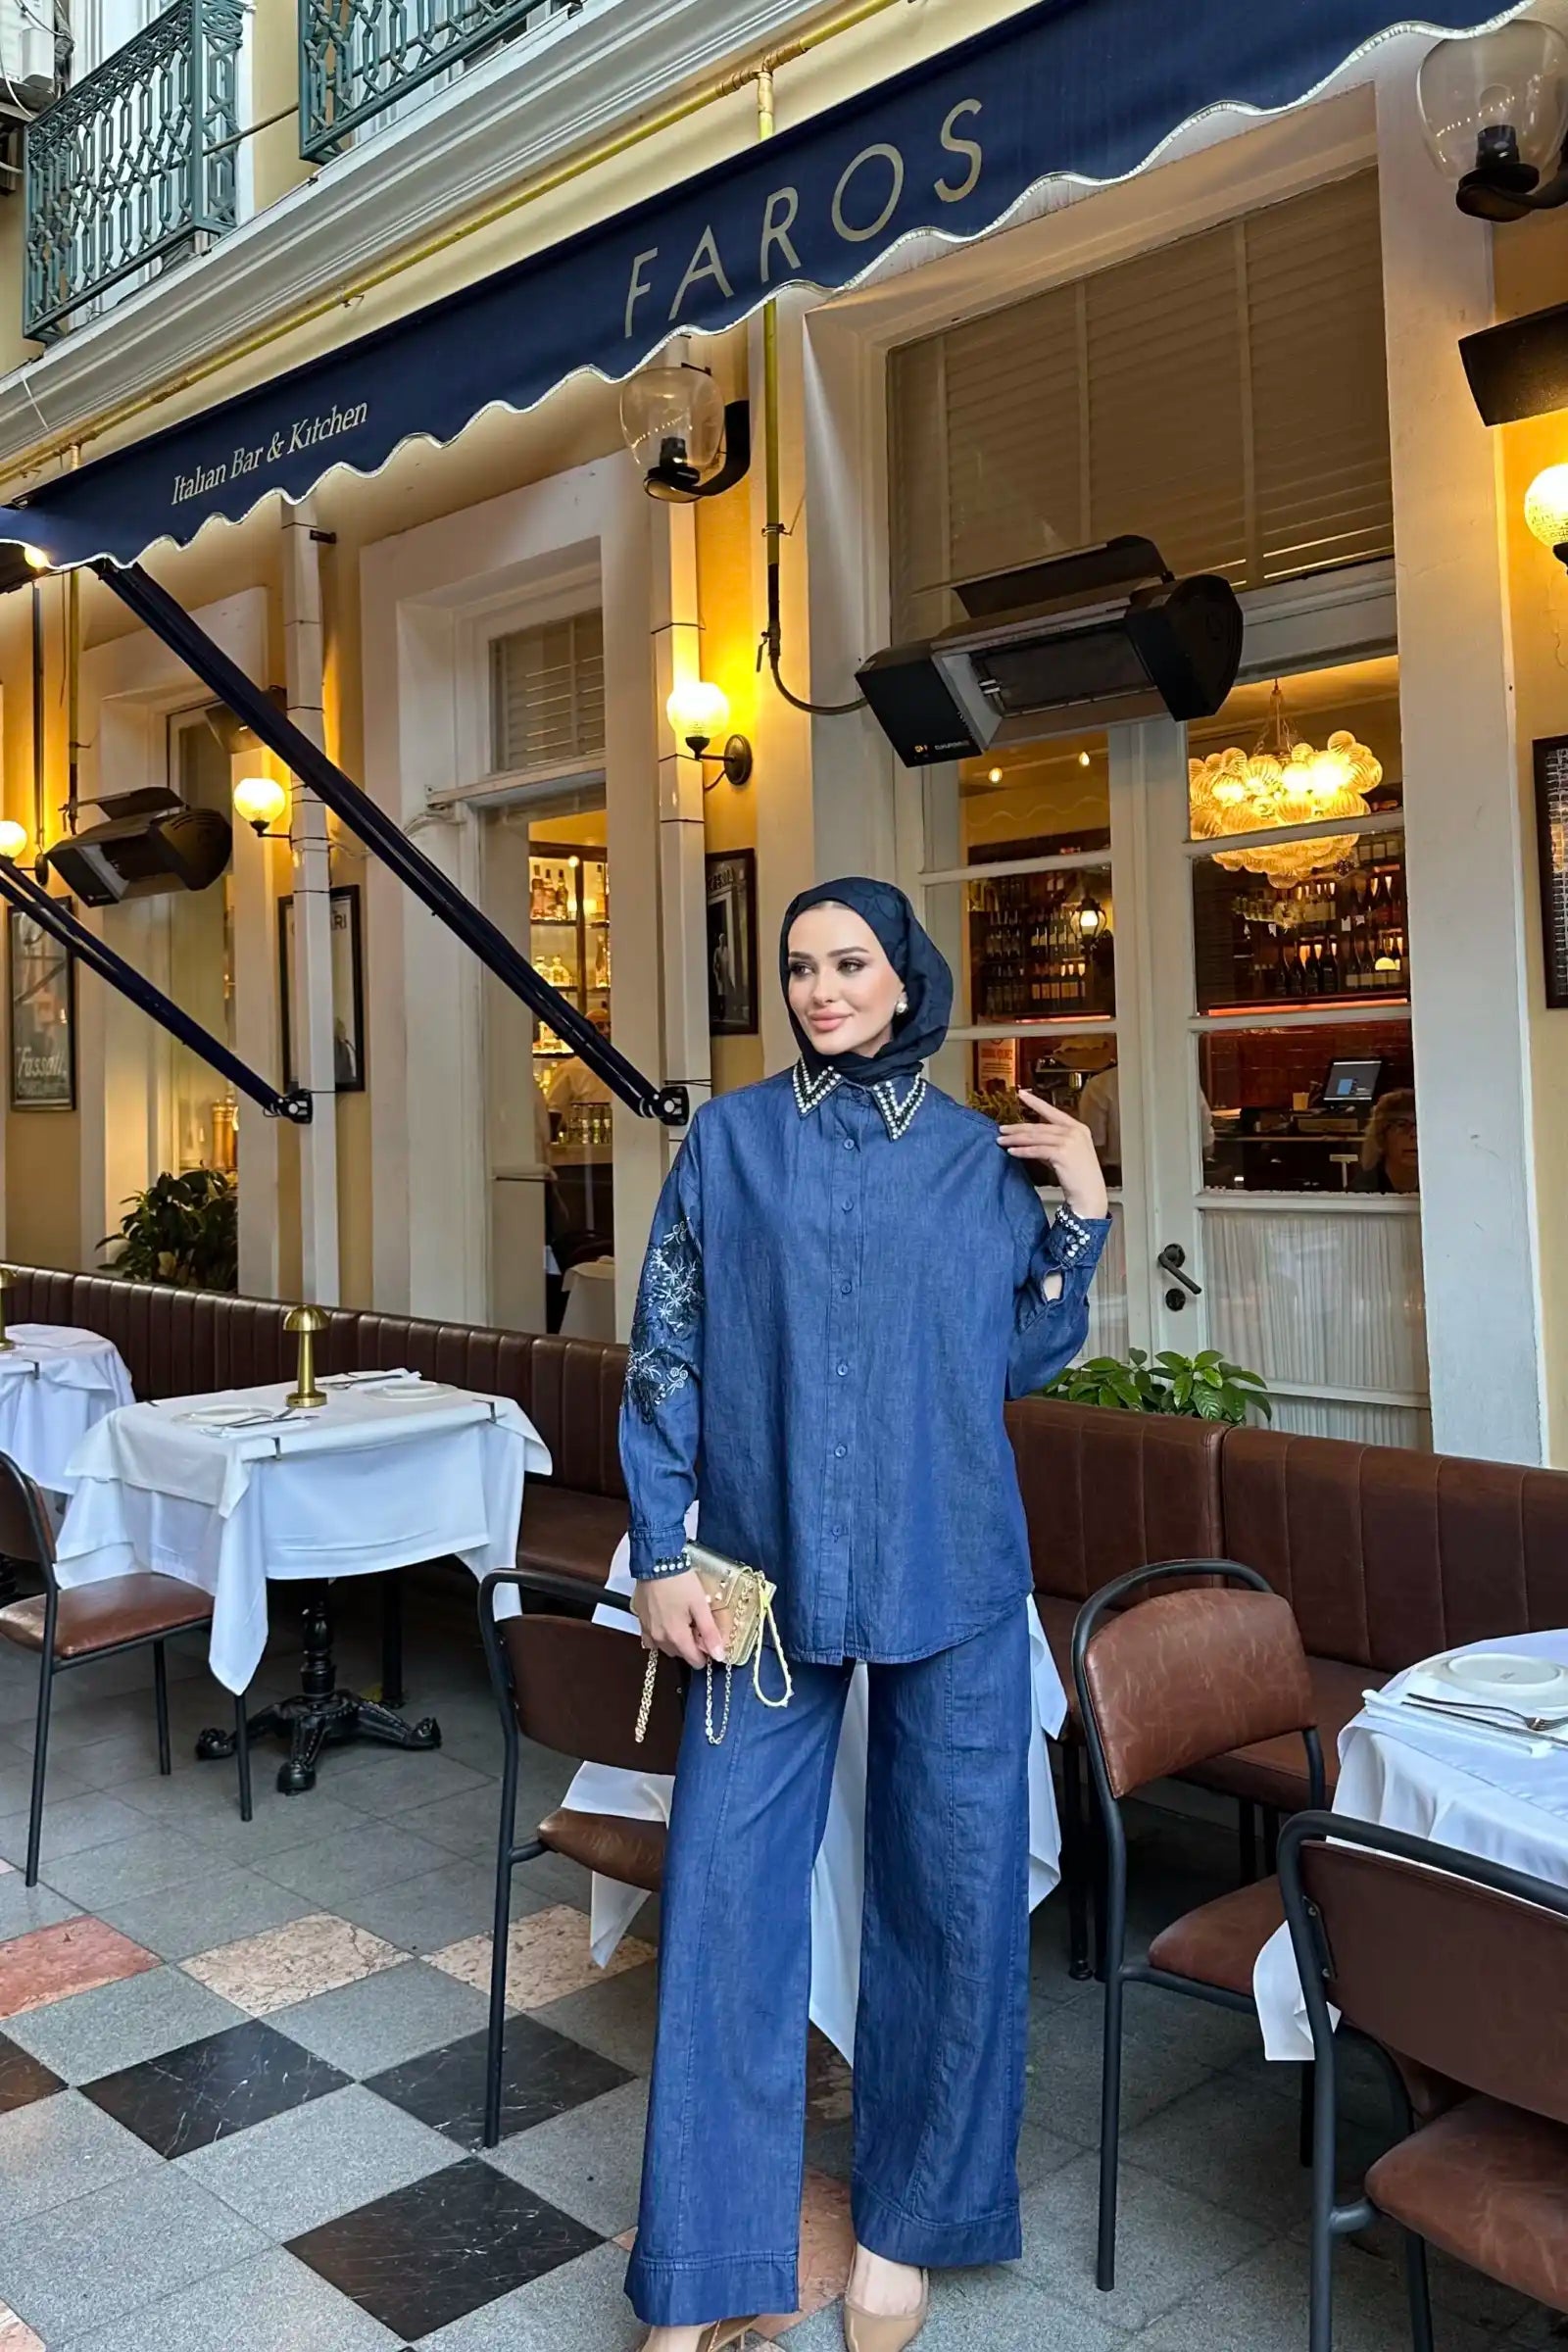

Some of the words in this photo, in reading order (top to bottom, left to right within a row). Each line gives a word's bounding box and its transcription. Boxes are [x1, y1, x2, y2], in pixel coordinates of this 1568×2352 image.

[624, 98, 982, 338] FAROS
[171, 463, 226, 506] Italian
[230, 447, 264, 479] Bar
[267, 431, 285, 463] &
[287, 402, 368, 455] Kitchen
